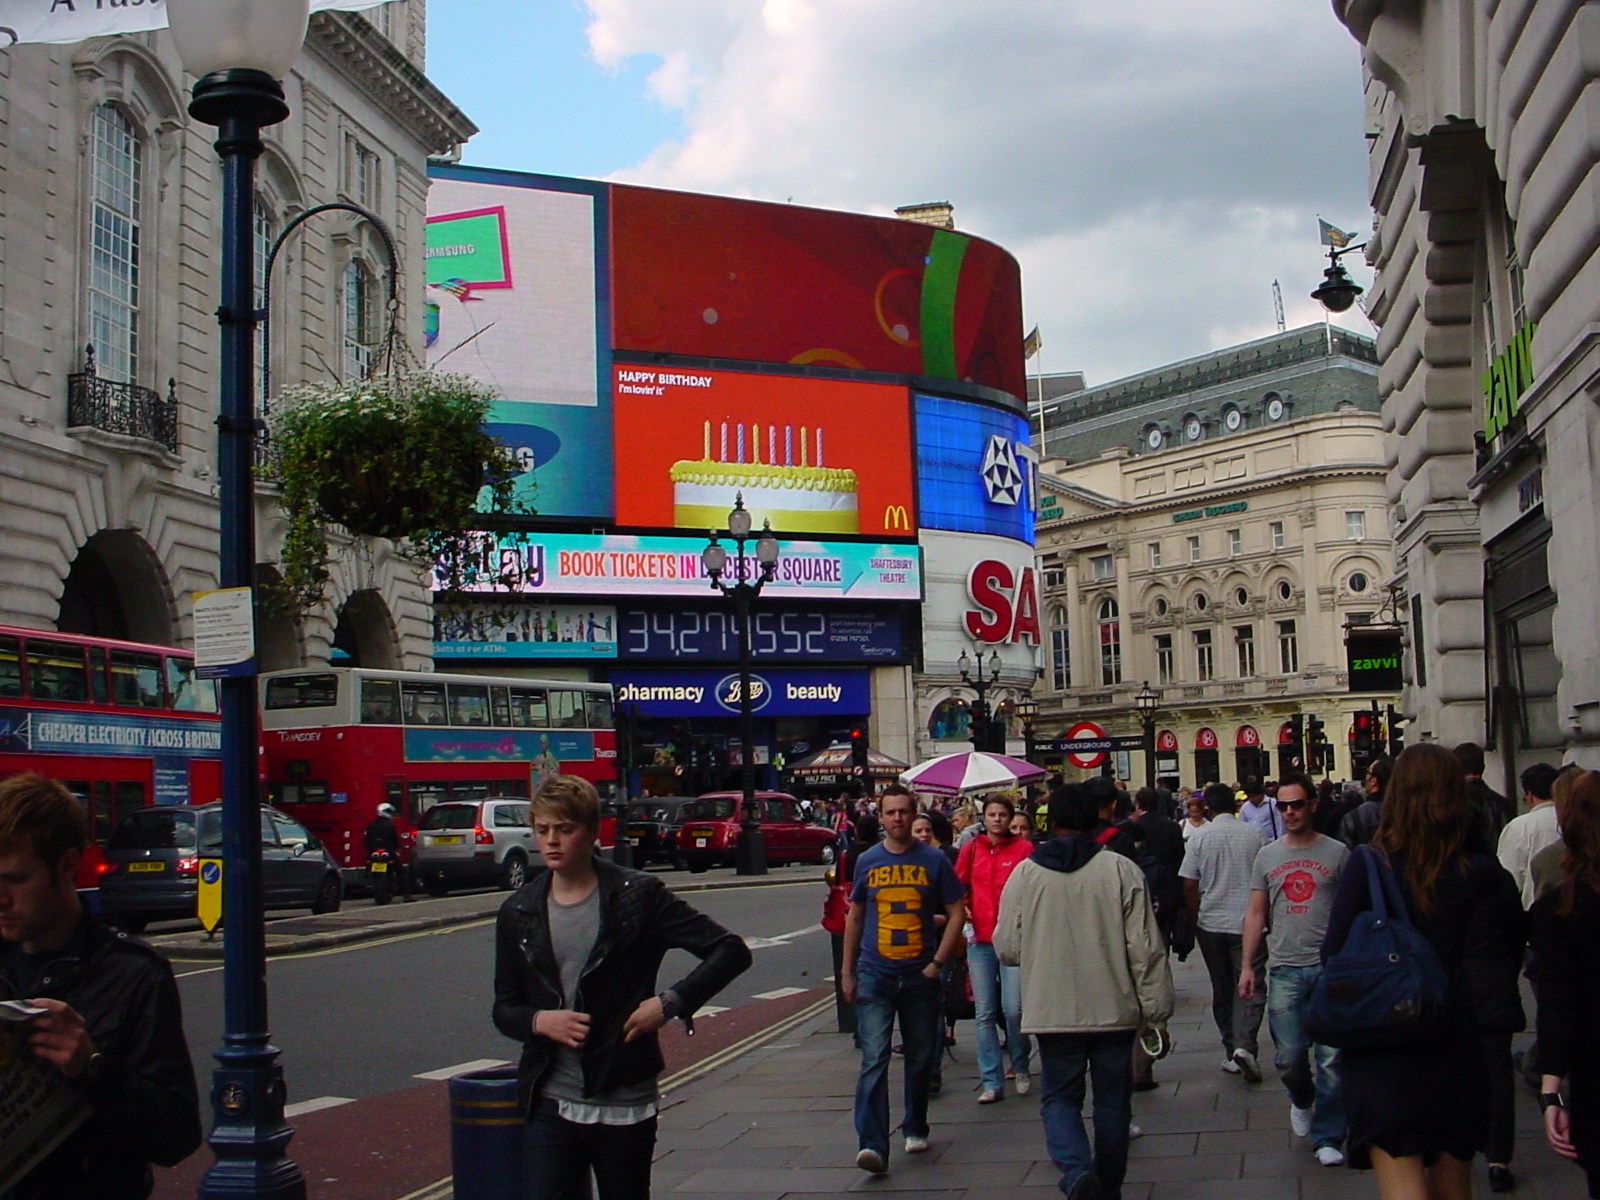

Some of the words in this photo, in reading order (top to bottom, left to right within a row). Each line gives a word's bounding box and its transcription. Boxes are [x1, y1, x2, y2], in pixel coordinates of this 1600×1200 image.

[618, 370, 656, 383] HAPPY
[658, 374, 713, 388] BIRTHDAY
[1481, 319, 1538, 444] zavv
[560, 551, 607, 577] BOOK
[609, 552, 676, 579] TICKETS
[680, 555, 696, 579] IN
[700, 556, 780, 581] LCESTR
[783, 557, 842, 585] SQUARE
[870, 558, 913, 570] SHAFTESBURY
[878, 572, 906, 584] THEATRE
[482, 644, 506, 654] ATMs
[1352, 652, 1397, 671] zavvi
[618, 683, 704, 703] pharmacy
[723, 679, 764, 704] Bts
[787, 683, 842, 703] beauty
[38, 721, 86, 743] CHEAPER
[88, 724, 146, 746] ELECTRICITY
[147, 728, 184, 748] ACROSS
[184, 730, 222, 750] BRITAIN
[1034, 744, 1054, 754] PUBLIC
[1060, 740, 1112, 754] UNDERGROUND
[867, 864, 929, 887] OSAKA
[875, 886, 923, 961] 6
